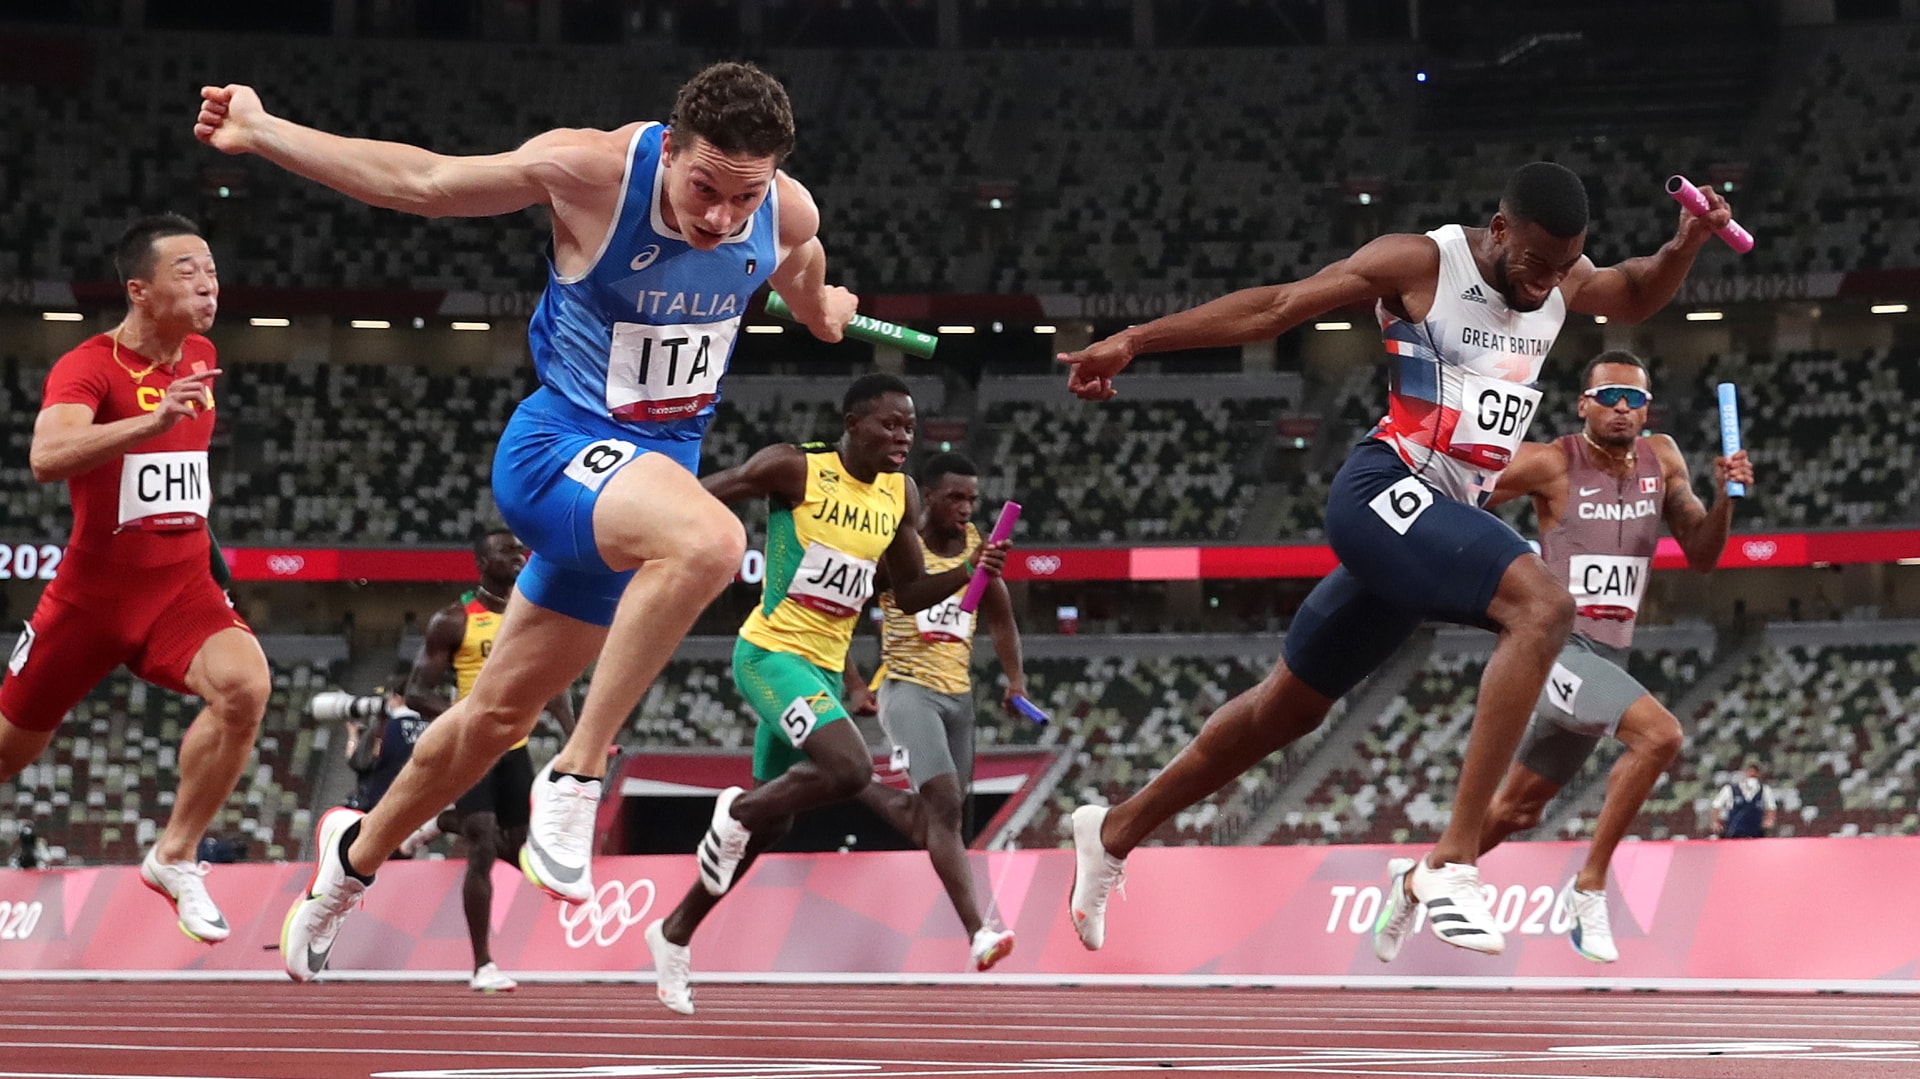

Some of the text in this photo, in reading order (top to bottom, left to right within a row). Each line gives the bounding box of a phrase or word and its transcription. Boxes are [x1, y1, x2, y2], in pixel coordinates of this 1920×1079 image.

[636, 290, 737, 316] ITALIA
[1462, 326, 1506, 352] GREAT
[637, 335, 711, 387] ITA
[1477, 389, 1533, 440] GBR
[583, 445, 623, 474] 8
[137, 462, 201, 503] CHN
[1389, 489, 1421, 519] 6
[1578, 499, 1657, 521] CANADA
[806, 557, 868, 598] JAM
[1583, 564, 1639, 597] CAN
[1551, 677, 1573, 702] 4
[784, 706, 808, 739] 5
